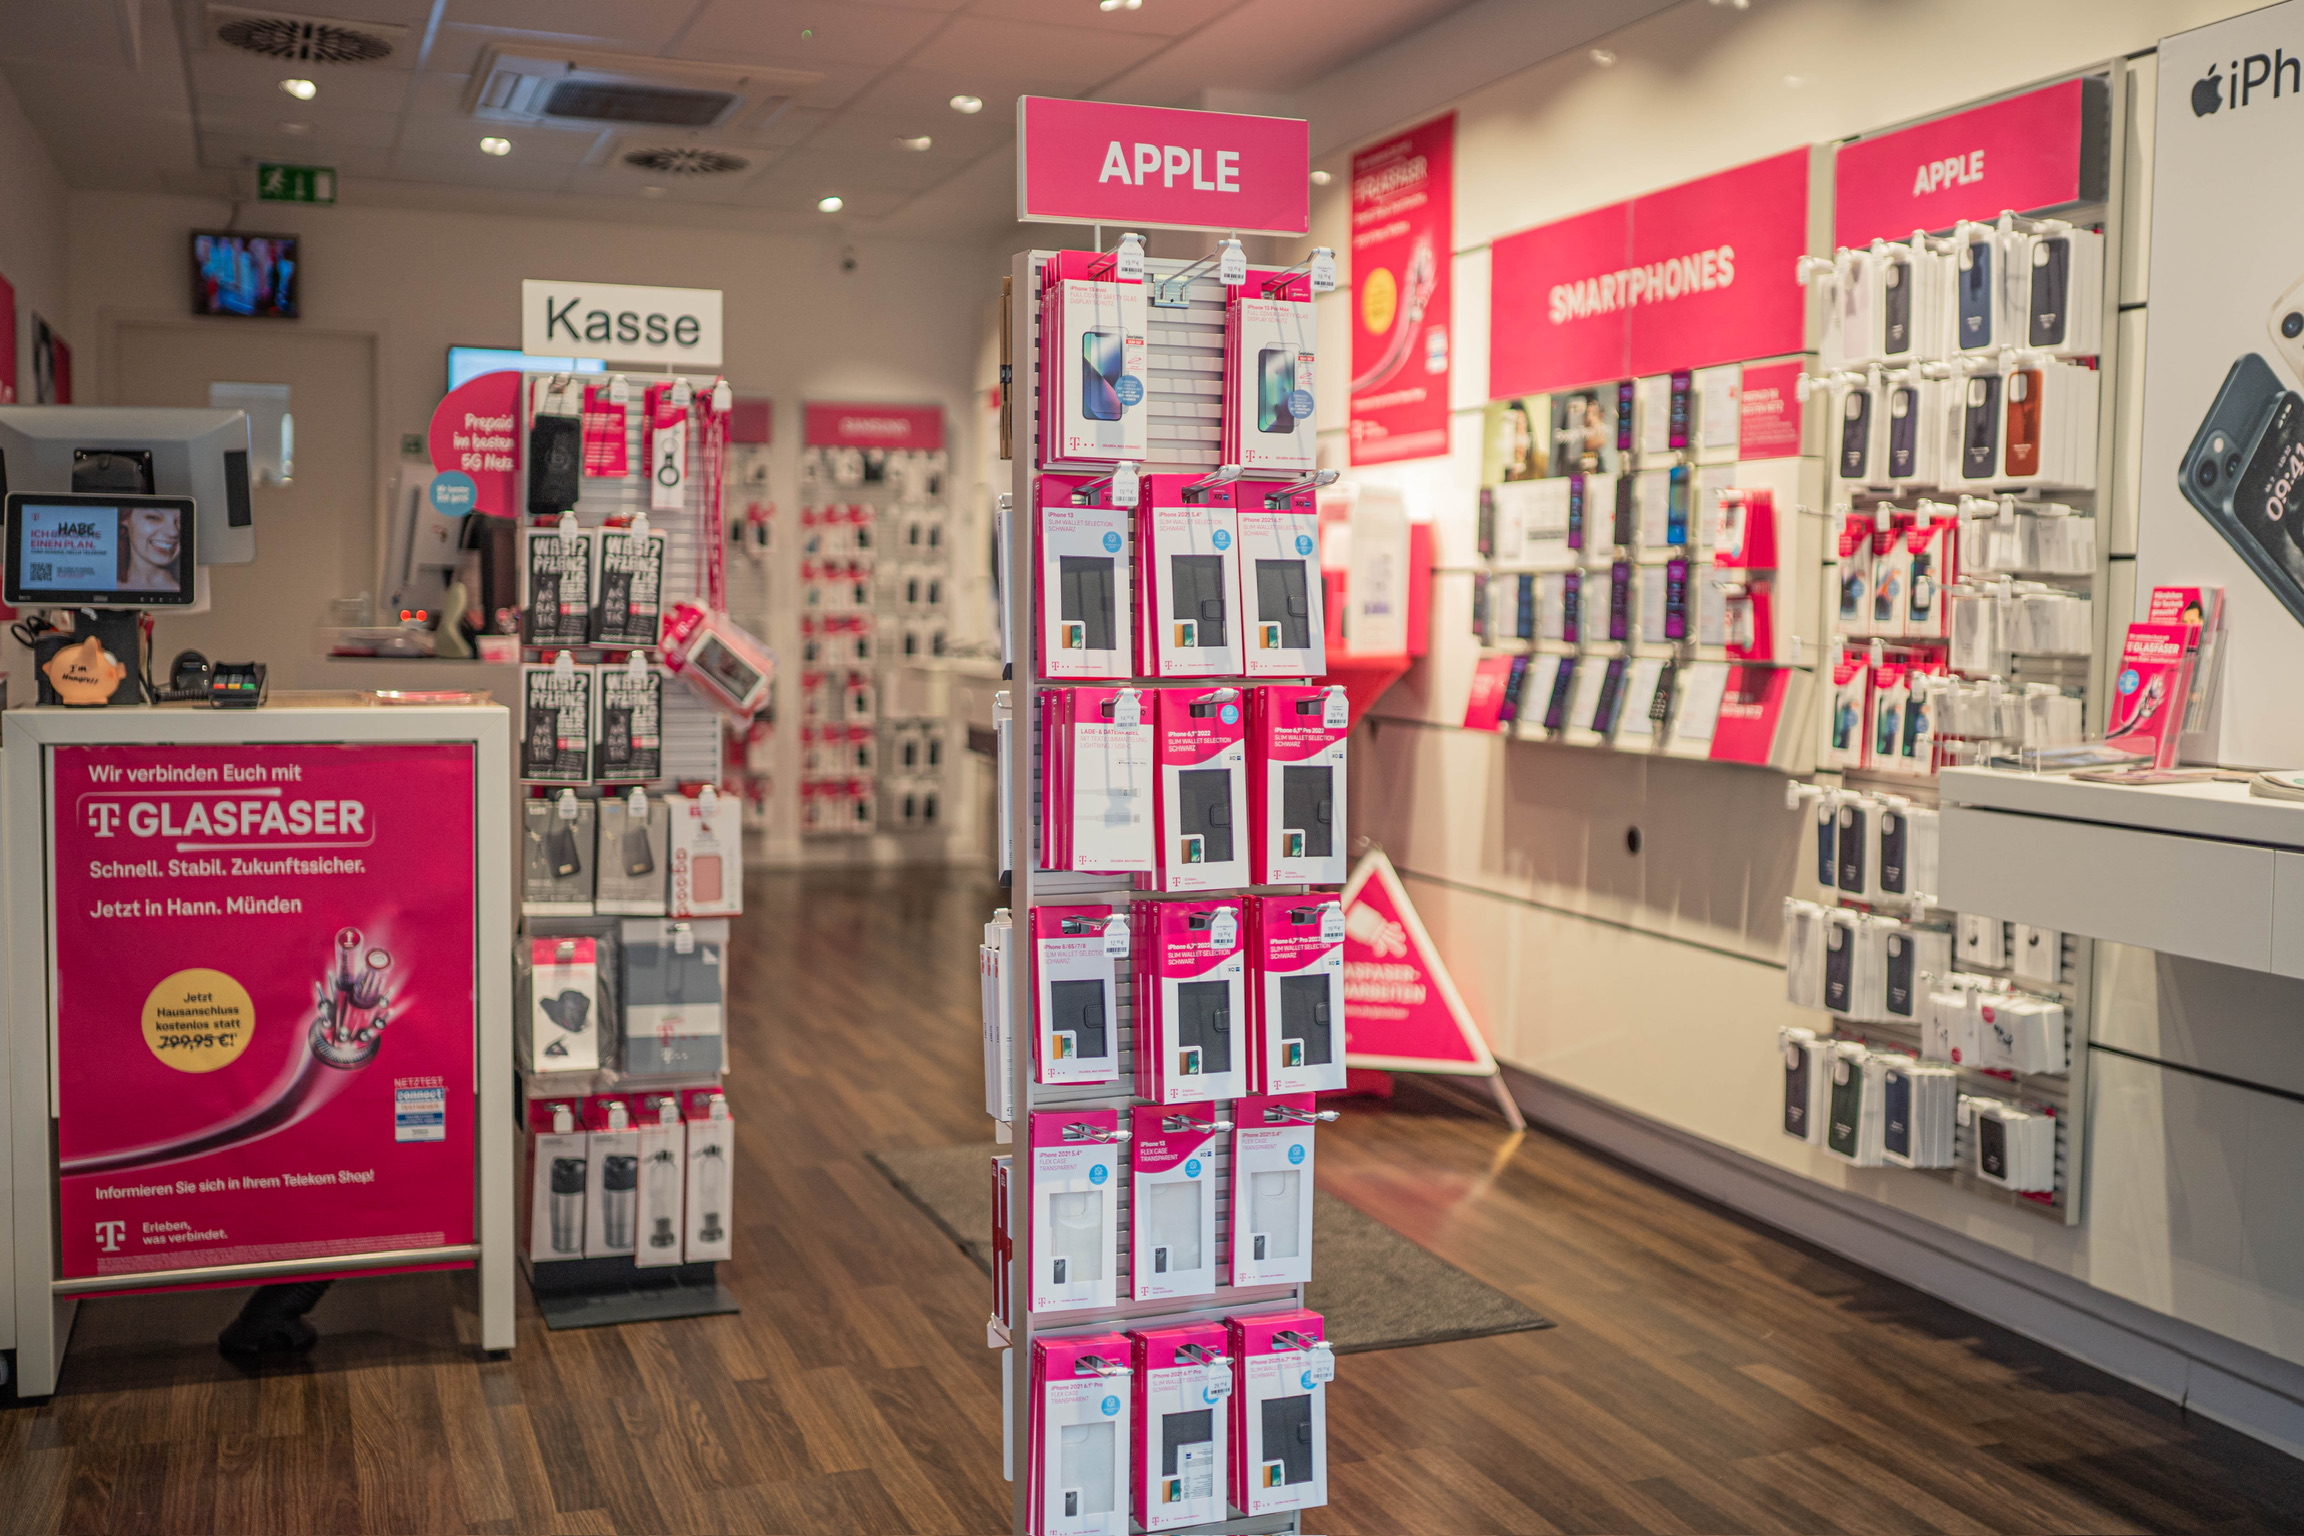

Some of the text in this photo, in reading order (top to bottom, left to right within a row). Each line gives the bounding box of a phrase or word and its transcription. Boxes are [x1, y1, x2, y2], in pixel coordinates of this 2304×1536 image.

[1099, 141, 1240, 193] APPLE
[1912, 149, 1985, 198] APPLE
[1549, 245, 1735, 325] SMARTPHONES
[546, 296, 701, 346] Kasse
[464, 413, 514, 435] Prepaid
[453, 431, 469, 450] im
[461, 453, 514, 472] 5G Netz
[30, 529, 49, 538] ICH
[58, 521, 96, 536] HABE
[30, 538, 62, 548] EINEN
[2133, 641, 2180, 654] GLASFASER
[70, 664, 87, 673] I'm
[62, 673, 98, 685] Hungry!!
[88, 764, 302, 782] Wir verbinden Euch mit
[128, 800, 365, 837] GLASFASER
[89, 856, 366, 879] Schnell. Stabil. Zukunftssicher.
[89, 895, 302, 918] Jetzt in Hann. Münden
[183, 992, 213, 1003] Jetzt
[157, 1005, 239, 1017] Hausanschluss
[156, 1019, 240, 1032] kostenlos statt
[157, 1034, 213, 1052] 799,95
[394, 1076, 444, 1087] NETZTEST
[1141, 1154, 1178, 1162] TRANSPARENT
[95, 1168, 375, 1200] Informieren Sie sich in Ihrem Telekom Shop!
[142, 1220, 192, 1234] Erleben,
[142, 1228, 228, 1245] was verbindet.
